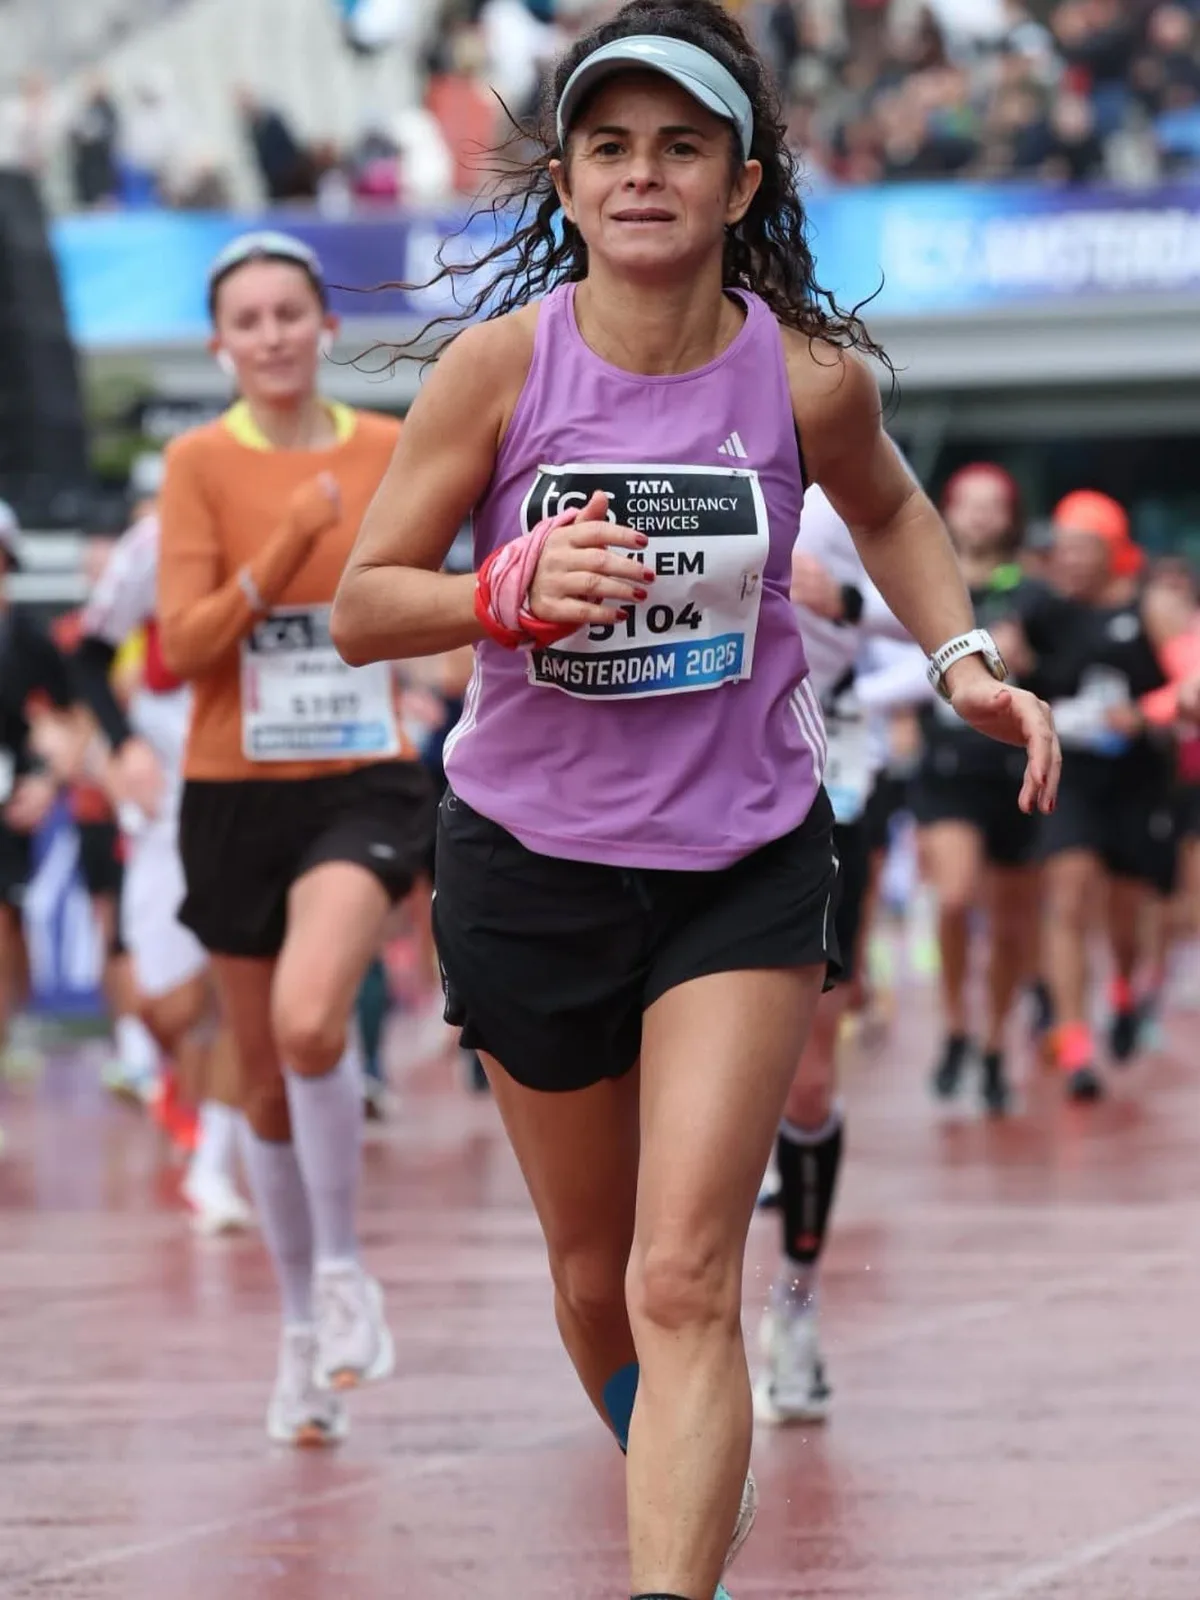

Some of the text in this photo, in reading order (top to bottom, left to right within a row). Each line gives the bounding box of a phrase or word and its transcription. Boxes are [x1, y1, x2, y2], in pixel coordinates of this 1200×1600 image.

[626, 480, 675, 494] TATA
[626, 497, 738, 513] CONSULTANCY
[627, 515, 700, 531] SERVICES
[540, 652, 676, 686] AMSTERDAM
